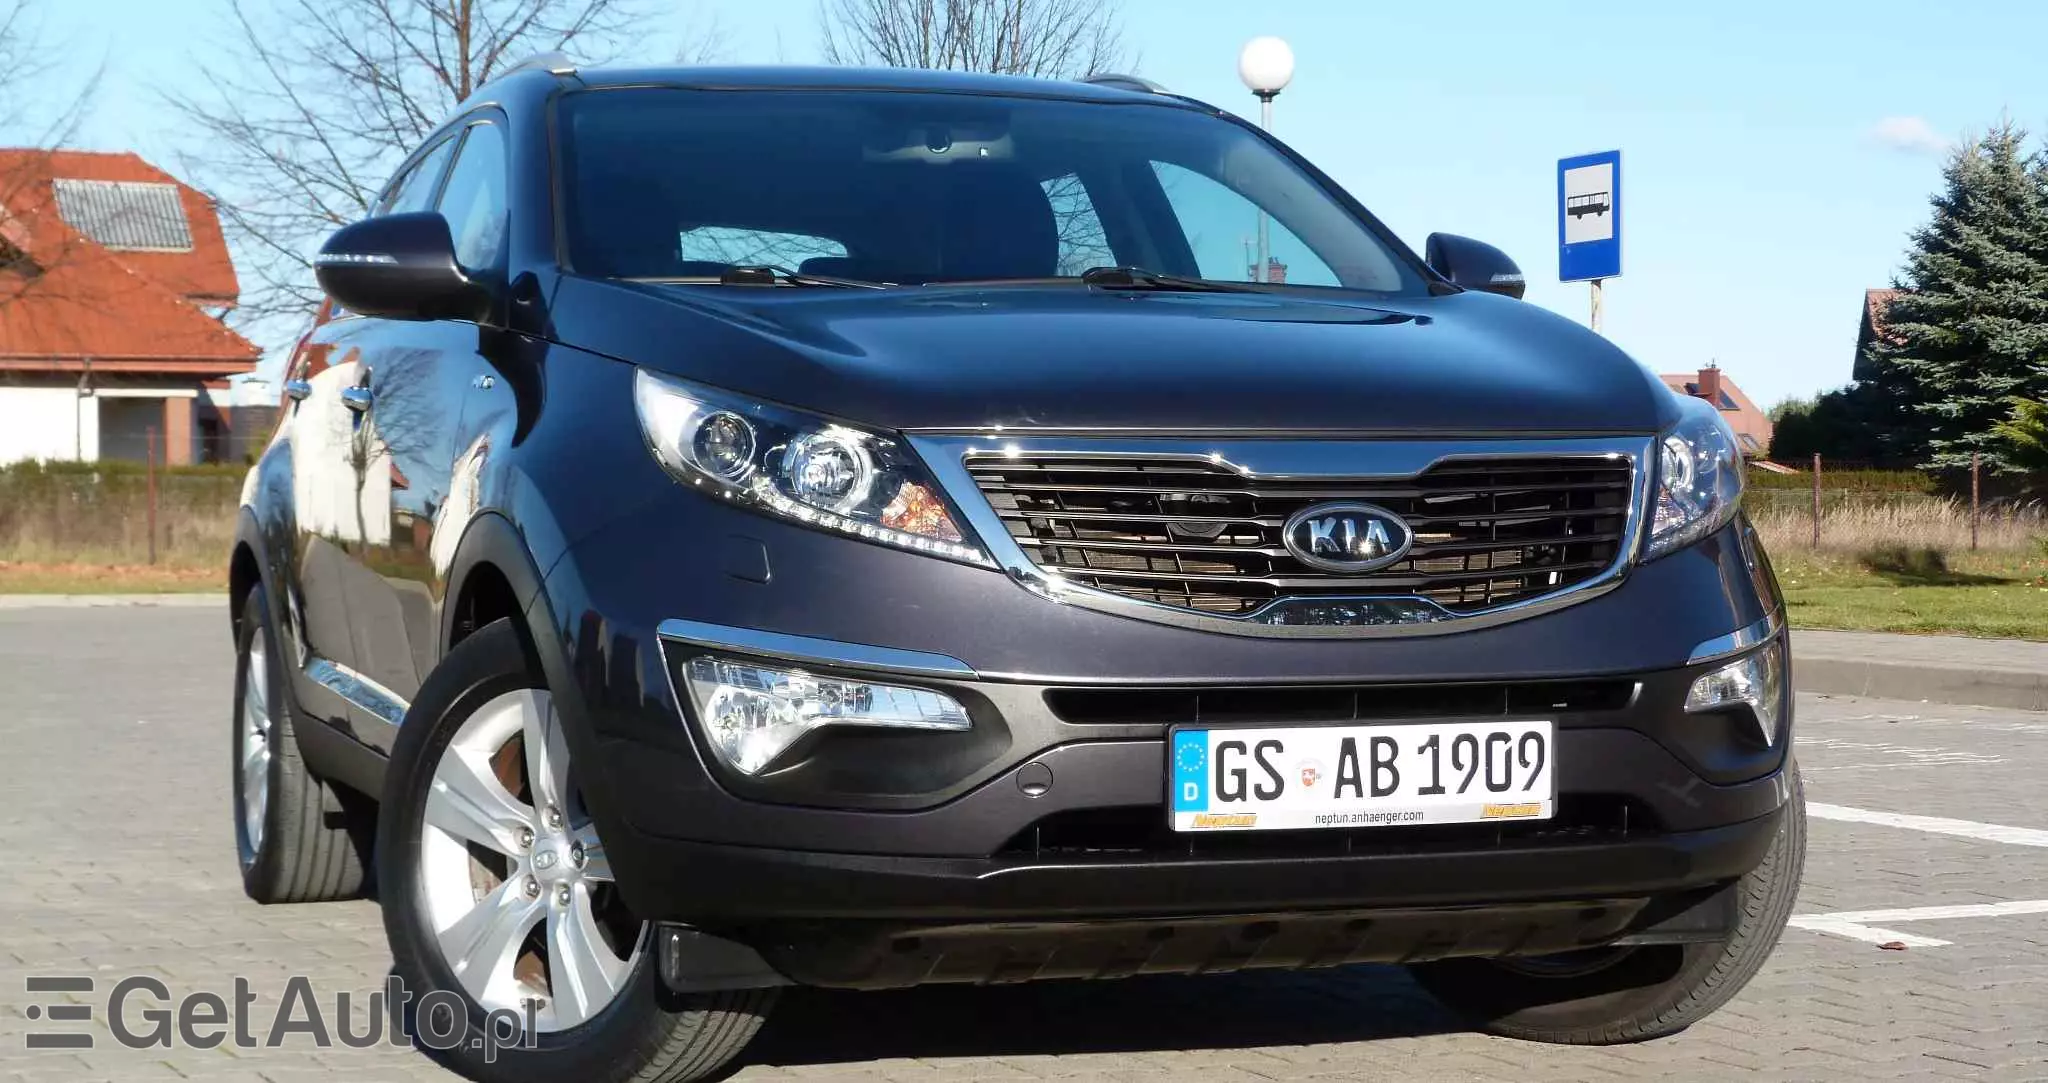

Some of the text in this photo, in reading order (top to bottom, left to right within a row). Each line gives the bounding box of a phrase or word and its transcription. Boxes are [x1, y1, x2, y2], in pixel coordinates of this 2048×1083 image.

[1307, 517, 1392, 553] KIA
[1215, 731, 1545, 802] GS AB 1909
[1184, 782, 1199, 801] D
[1315, 810, 1424, 826] neptun.anhaenger.com
